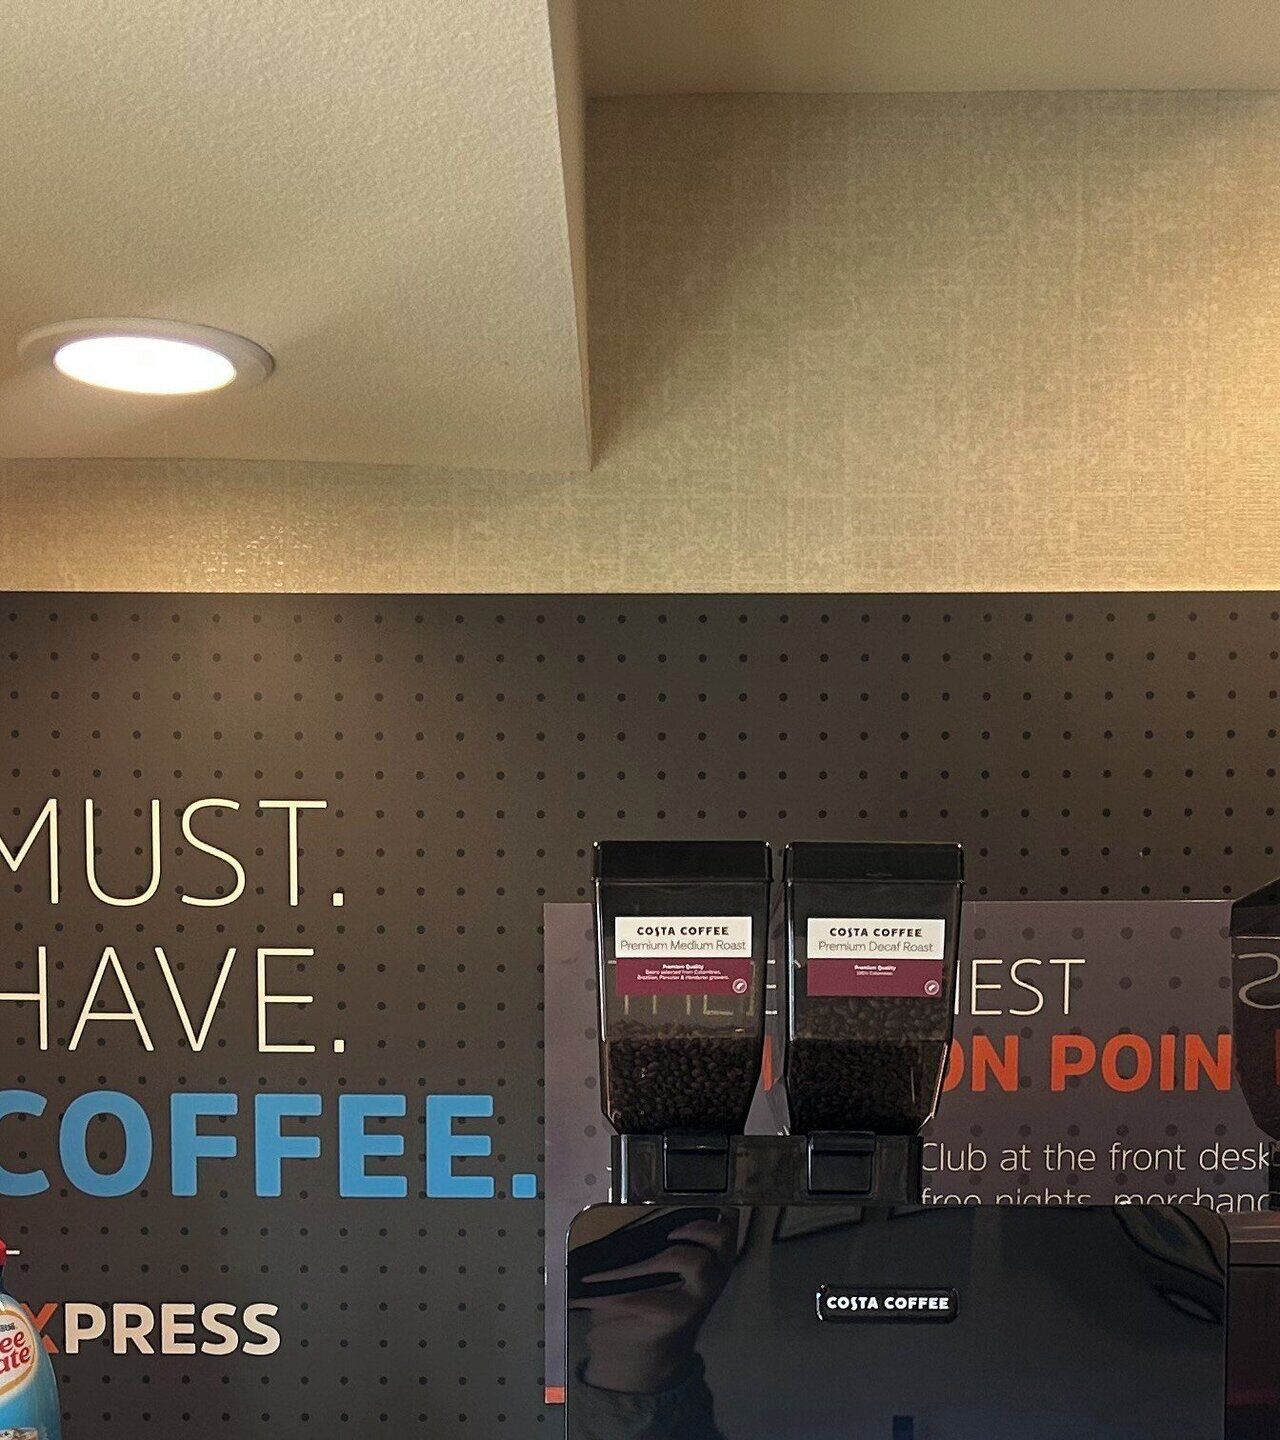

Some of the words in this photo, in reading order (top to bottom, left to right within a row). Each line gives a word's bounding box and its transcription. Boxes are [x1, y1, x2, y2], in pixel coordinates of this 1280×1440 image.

[636, 926, 676, 937] COSTA
[680, 926, 729, 936] COFFEE
[829, 928, 869, 938] COSTA
[873, 928, 923, 938] COFFEE
[620, 940, 668, 951] Premium
[670, 940, 714, 951] Medium
[716, 940, 747, 951] Roast
[818, 941, 866, 952] Premium
[869, 941, 902, 952] Decaf
[903, 942, 934, 953] Roast
[1050, 1033, 1232, 1092] POIN
[922, 1142, 987, 1171] Club
[1000, 1145, 1031, 1171] at
[1043, 1142, 1096, 1171] the
[1109, 1142, 1187, 1171] front
[1199, 1142, 1270, 1171] desk
[826, 1296, 879, 1311] COSTA
[884, 1296, 950, 1310] COFFEE
[20, 1302, 282, 1356] XPRESS
